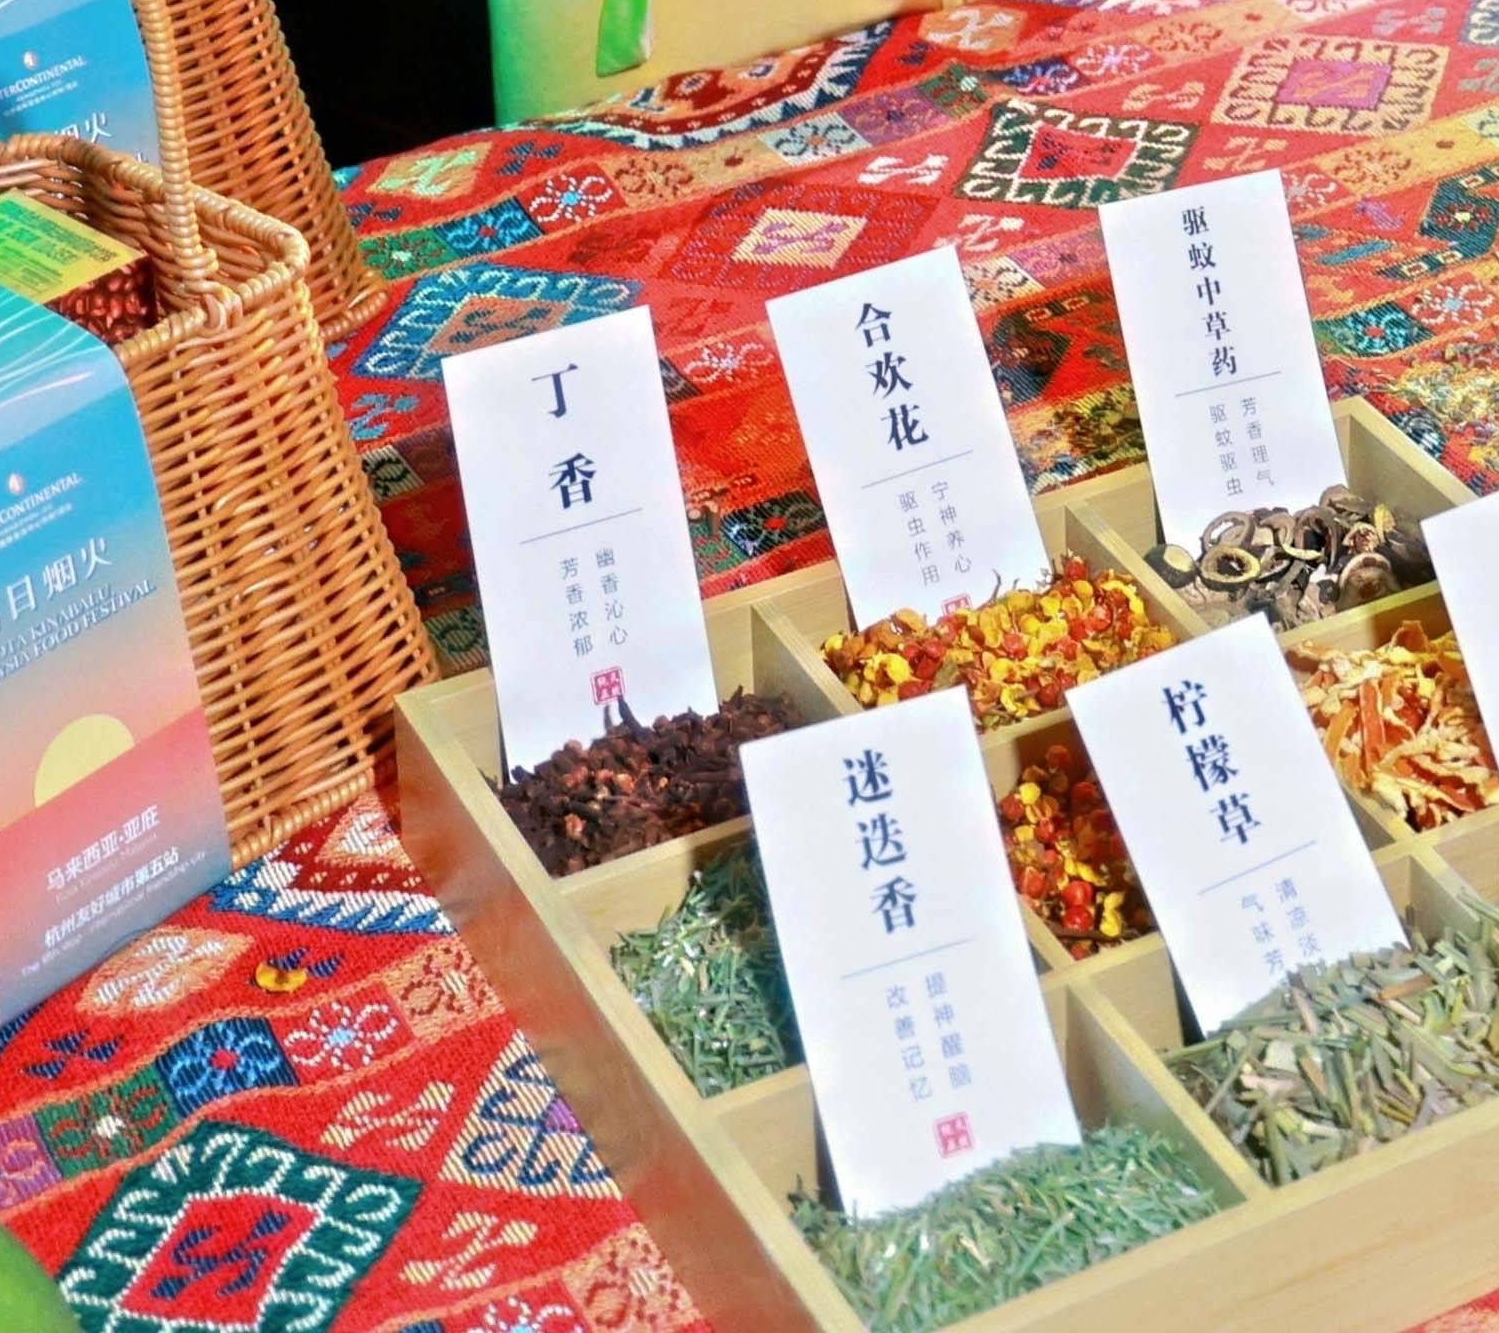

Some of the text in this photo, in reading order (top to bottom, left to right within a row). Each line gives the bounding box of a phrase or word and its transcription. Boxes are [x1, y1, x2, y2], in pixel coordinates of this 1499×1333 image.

[1182, 206, 1238, 376] 驱蚊中草药
[855, 302, 929, 451] 合欢花
[530, 362, 597, 510] 丁香
[1209, 403, 1243, 496] 驱蚊驱虫
[1240, 396, 1275, 486] 芳香理气
[898, 493, 940, 587] 驱虫作用
[930, 481, 972, 574] 宁神养心
[33, 619, 81, 659] FOOD
[559, 557, 593, 658] 芳香浓郁
[596, 547, 628, 647] 幽香沁心
[1161, 680, 1262, 845] 柠檬草
[842, 749, 917, 934] 迷迭香
[885, 984, 934, 1102] 改善记忆
[925, 971, 972, 1090] 提神醒脑
